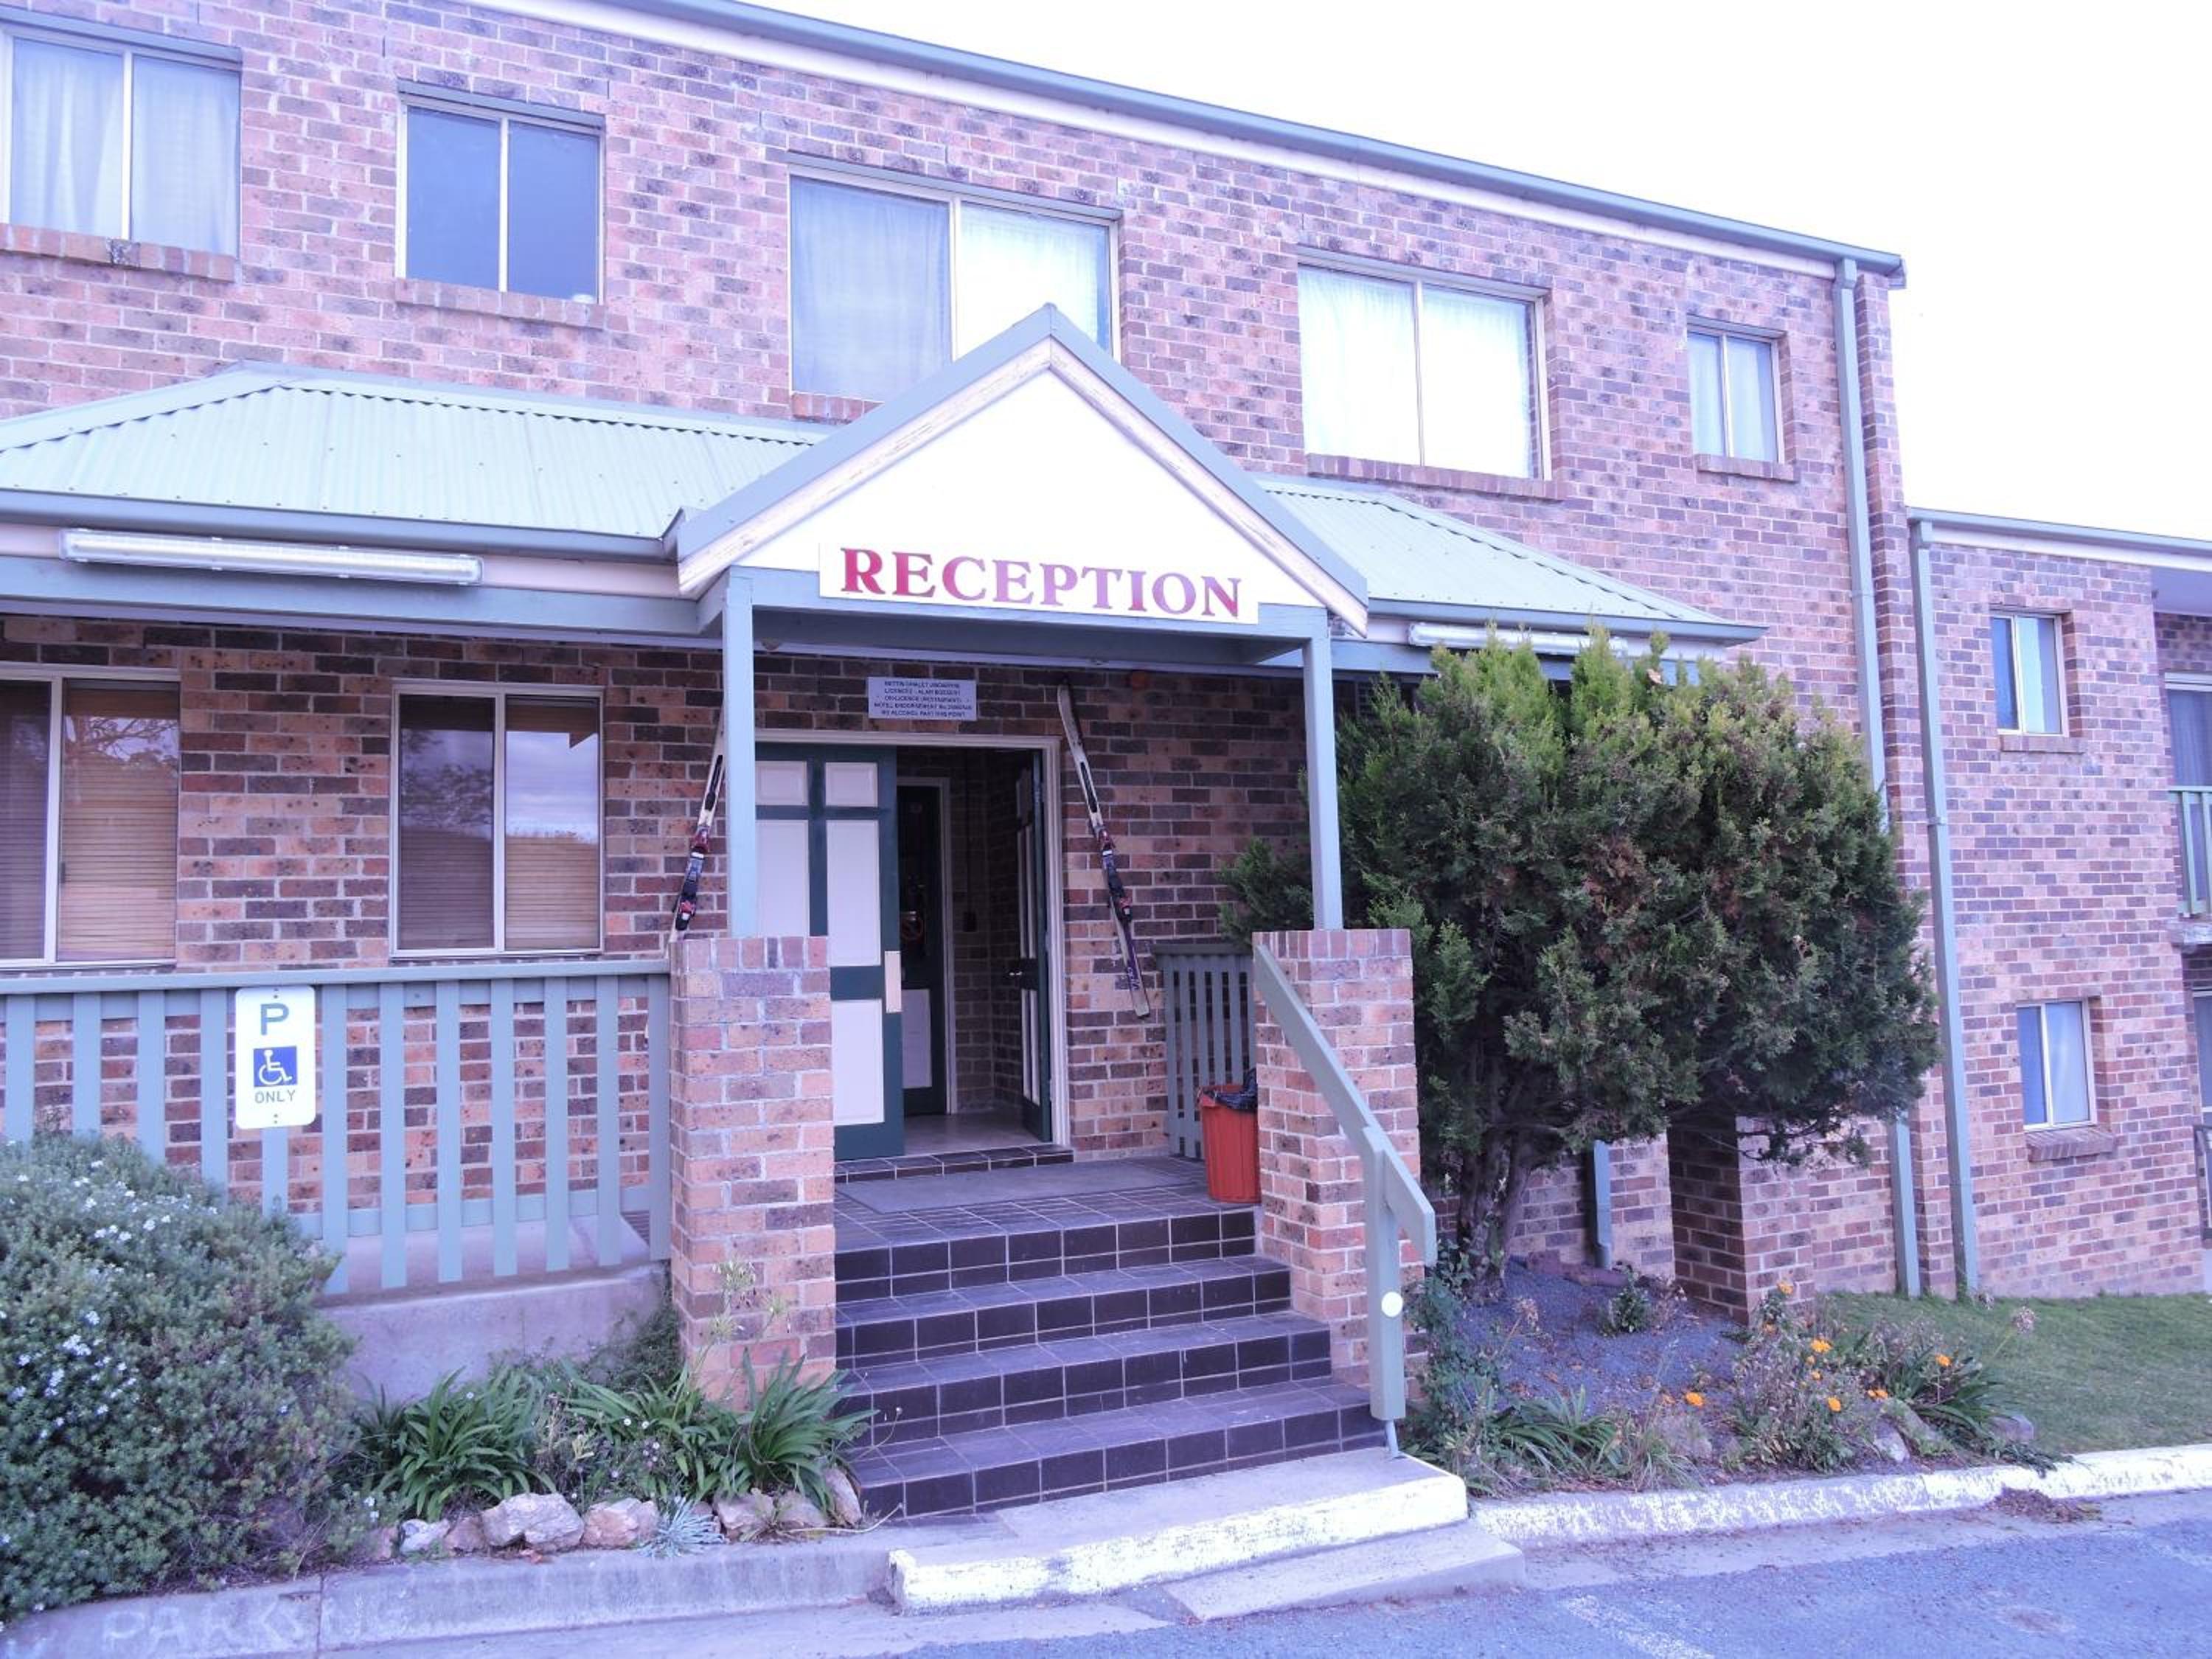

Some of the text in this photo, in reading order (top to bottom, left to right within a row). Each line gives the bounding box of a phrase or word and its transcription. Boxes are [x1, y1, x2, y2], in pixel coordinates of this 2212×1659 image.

[840, 547, 1242, 618] RECEPTION
[260, 1003, 290, 1036] P
[254, 1090, 296, 1104] ONLY
